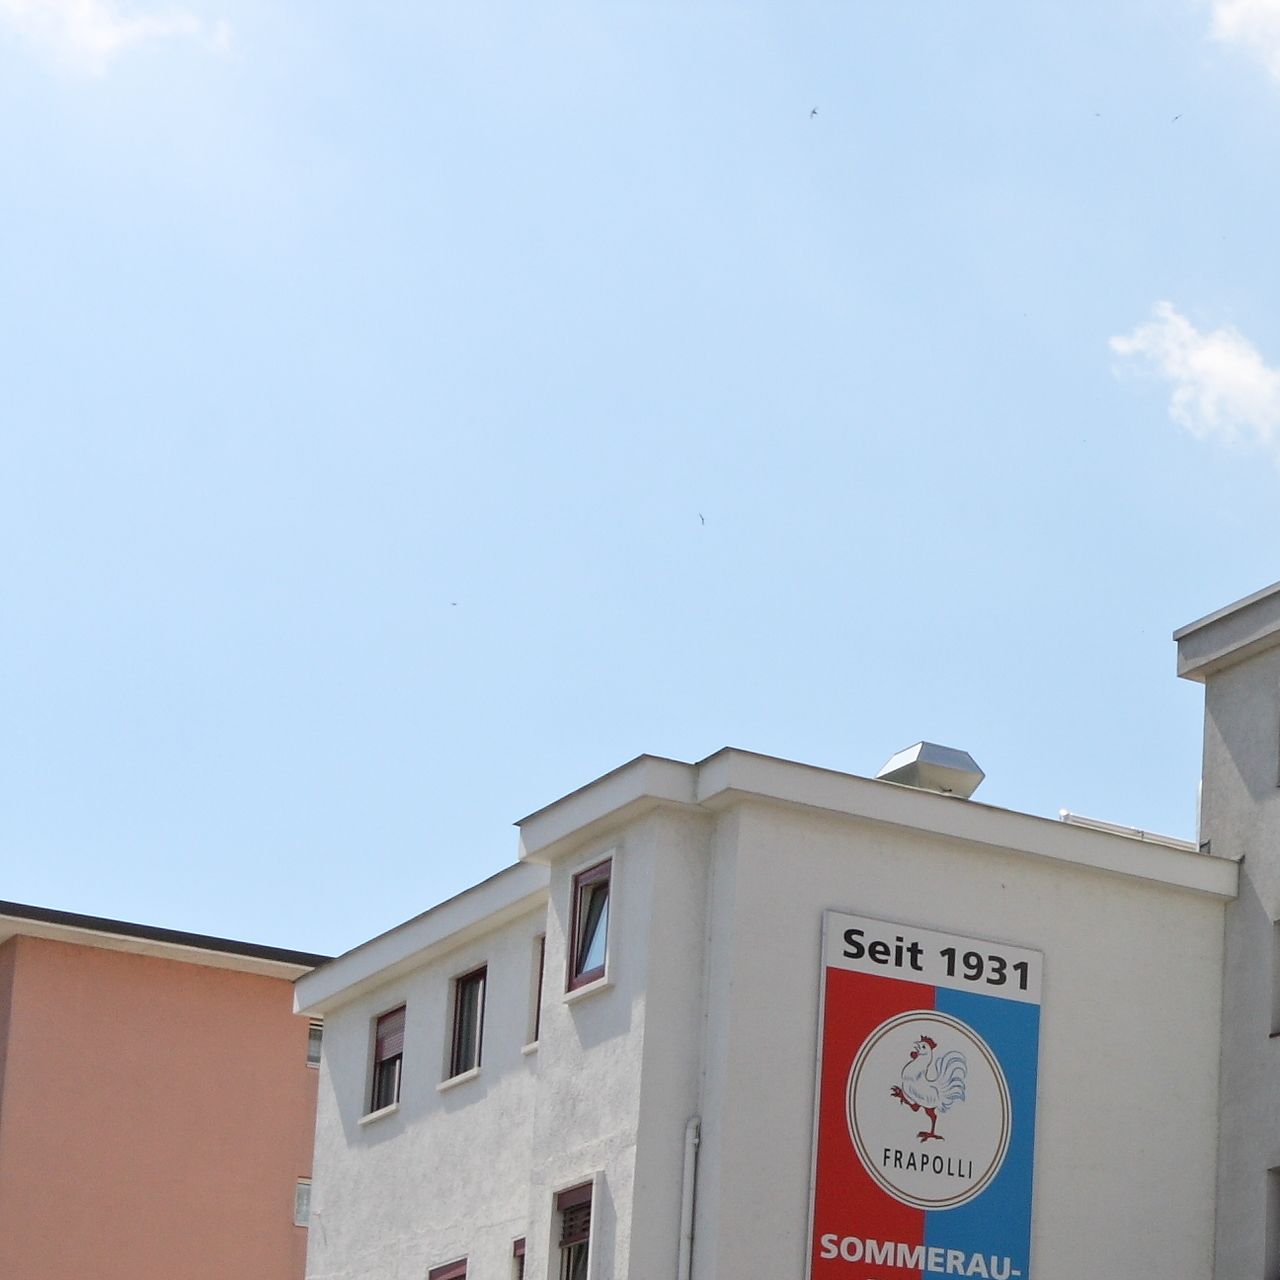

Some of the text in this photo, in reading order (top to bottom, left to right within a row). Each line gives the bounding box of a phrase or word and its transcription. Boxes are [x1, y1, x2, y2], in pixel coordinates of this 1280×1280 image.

[842, 927, 1030, 991] Seit 1931
[882, 1148, 974, 1180] FRAPOLLI
[820, 1233, 1022, 1280] SOMMERAU-
